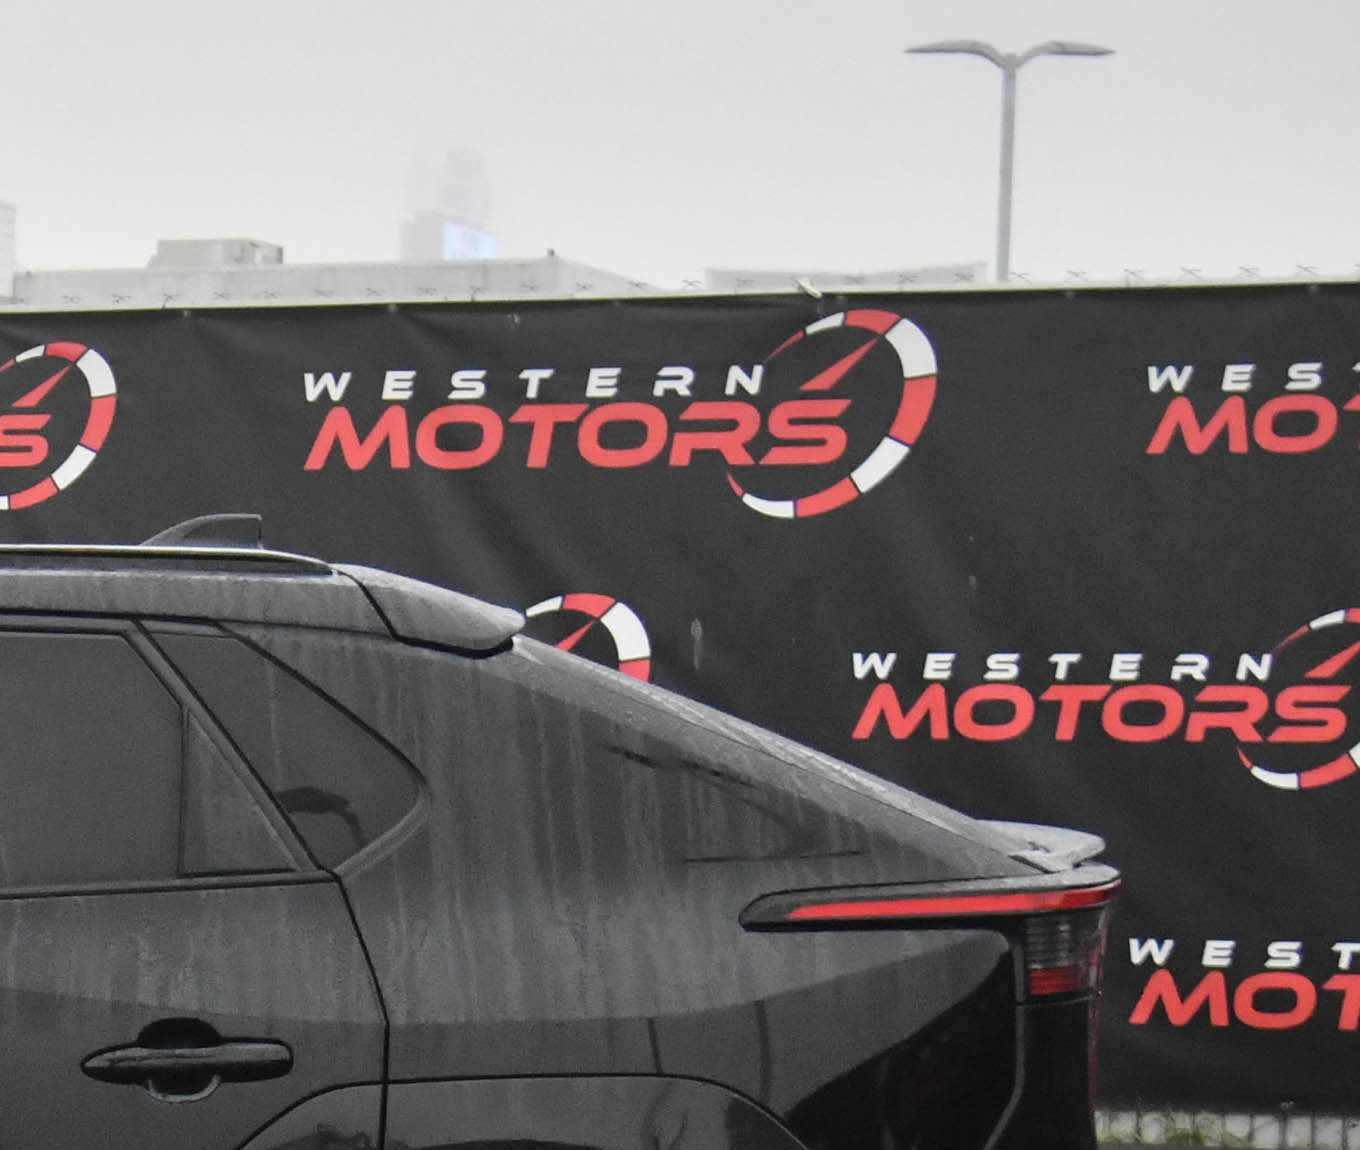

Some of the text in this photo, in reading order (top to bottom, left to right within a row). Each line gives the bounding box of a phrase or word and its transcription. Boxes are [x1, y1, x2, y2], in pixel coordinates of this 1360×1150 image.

[303, 364, 764, 402] WESTERN
[1147, 362, 1360, 393] WES
[305, 399, 852, 471] MOTORS
[852, 652, 1272, 681] WESTERN
[852, 682, 1351, 744] MOTORS
